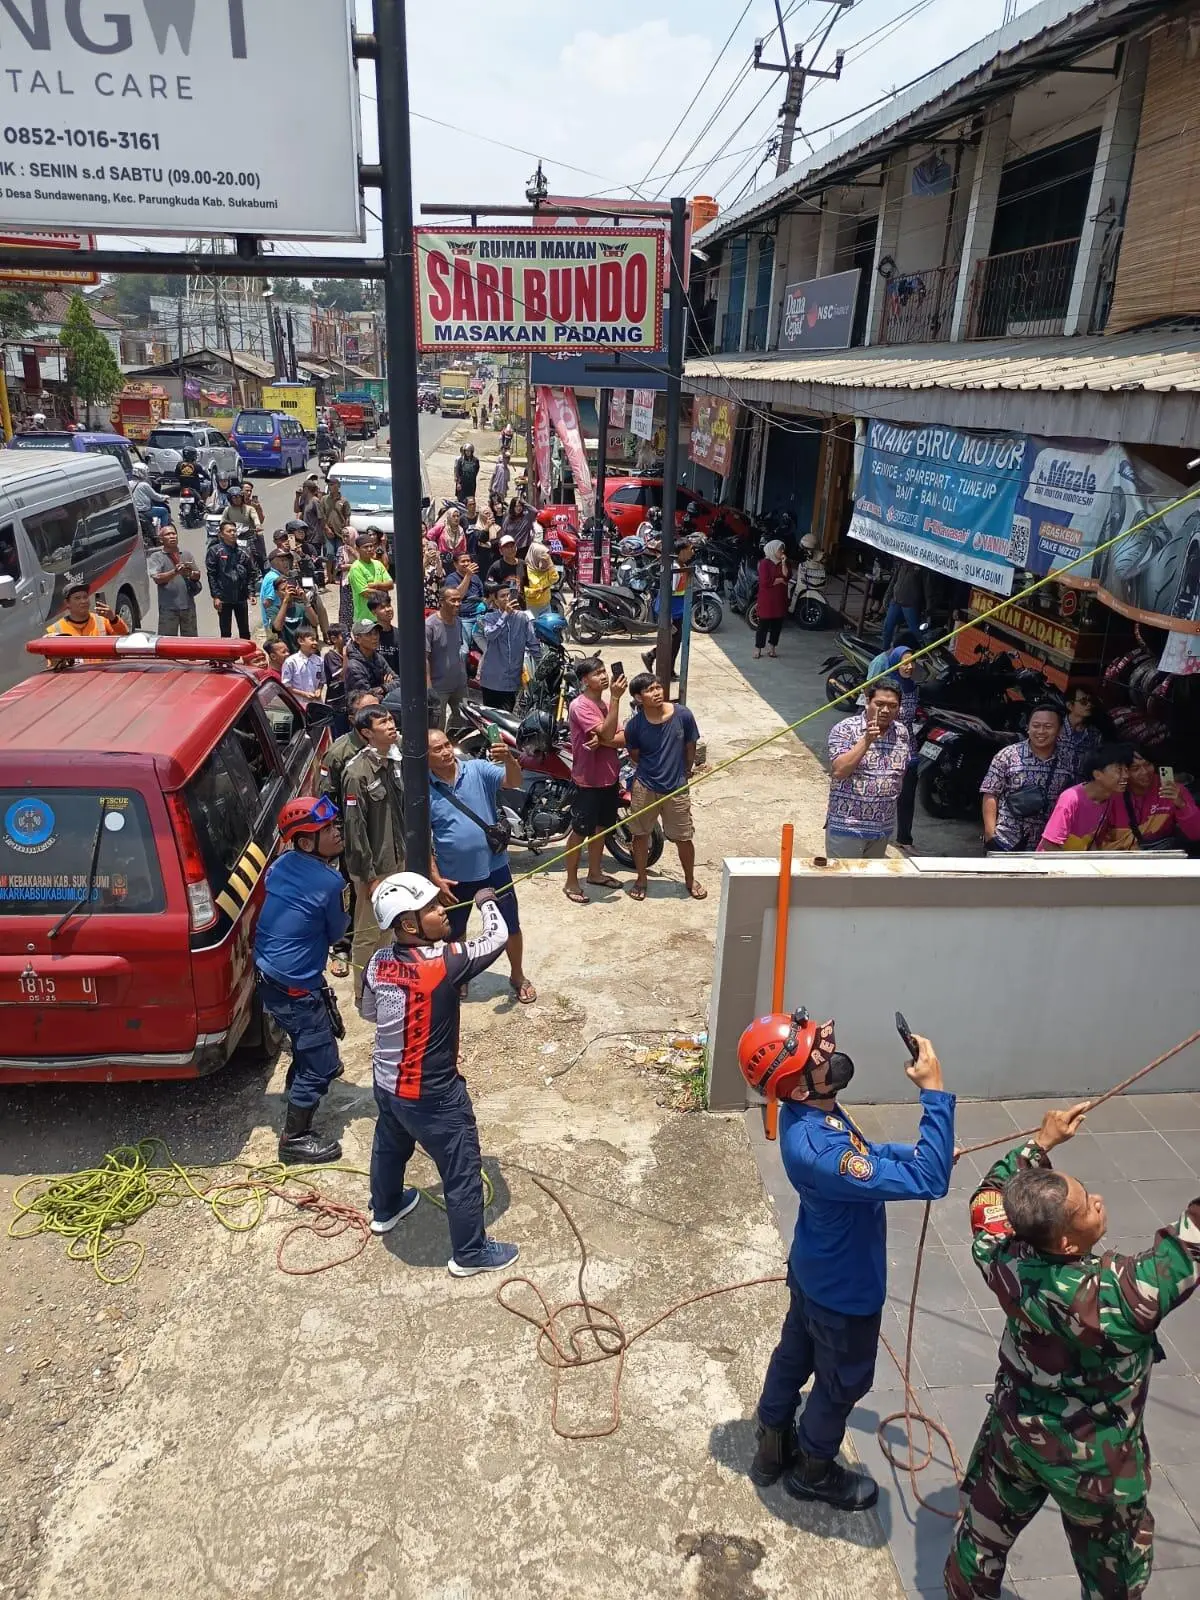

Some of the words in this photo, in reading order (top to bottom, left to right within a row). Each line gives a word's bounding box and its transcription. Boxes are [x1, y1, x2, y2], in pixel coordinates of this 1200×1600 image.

[6, 69, 74, 95] TAL
[94, 72, 193, 100] CARE
[4, 126, 160, 150] 0852-1016-3161
[29, 162, 78, 178] SENIN
[82, 165, 105, 180] s.d
[109, 166, 163, 183] SABTU
[168, 168, 261, 190] (09.00-20.00)
[6, 188, 32, 199] Desa
[34, 189, 111, 204] Sundawenang,
[113, 193, 136, 203] Kec.
[139, 194, 200, 207] Parungkuda
[202, 196, 226, 207] Kab.
[228, 197, 278, 209] Sukabumi
[479, 240, 537, 259] RUMAH
[541, 241, 597, 260] MAKAN
[427, 250, 514, 322] SARI
[523, 253, 648, 323] BUNDO
[786, 294, 806, 315] Dana
[817, 305, 834, 320] NSC
[434, 325, 547, 342] MASAKAN
[554, 326, 643, 343] PADANG
[916, 429, 957, 461] BIRU
[957, 435, 1027, 470] MOTOR
[905, 467, 951, 490] SPAREPART
[959, 478, 982, 497] TUNE
[983, 482, 997, 500] UP
[896, 484, 914, 500] BAUT
[920, 489, 938, 507] BAN
[941, 496, 957, 512] OLI
[1040, 540, 1057, 552] PAKE
[1057, 544, 1080, 558] MIZZLE
[919, 546, 959, 572] PARUNGKUDA
[965, 563, 1005, 586] SUKABUMI
[1022, 614, 1074, 651] PADANG
[9, 875, 52, 888] KEBAKARAN
[54, 875, 71, 888] KAB.
[73, 875, 110, 888] SUKBUMI
[18, 978, 56, 993] 1815
[82, 977, 92, 993] U
